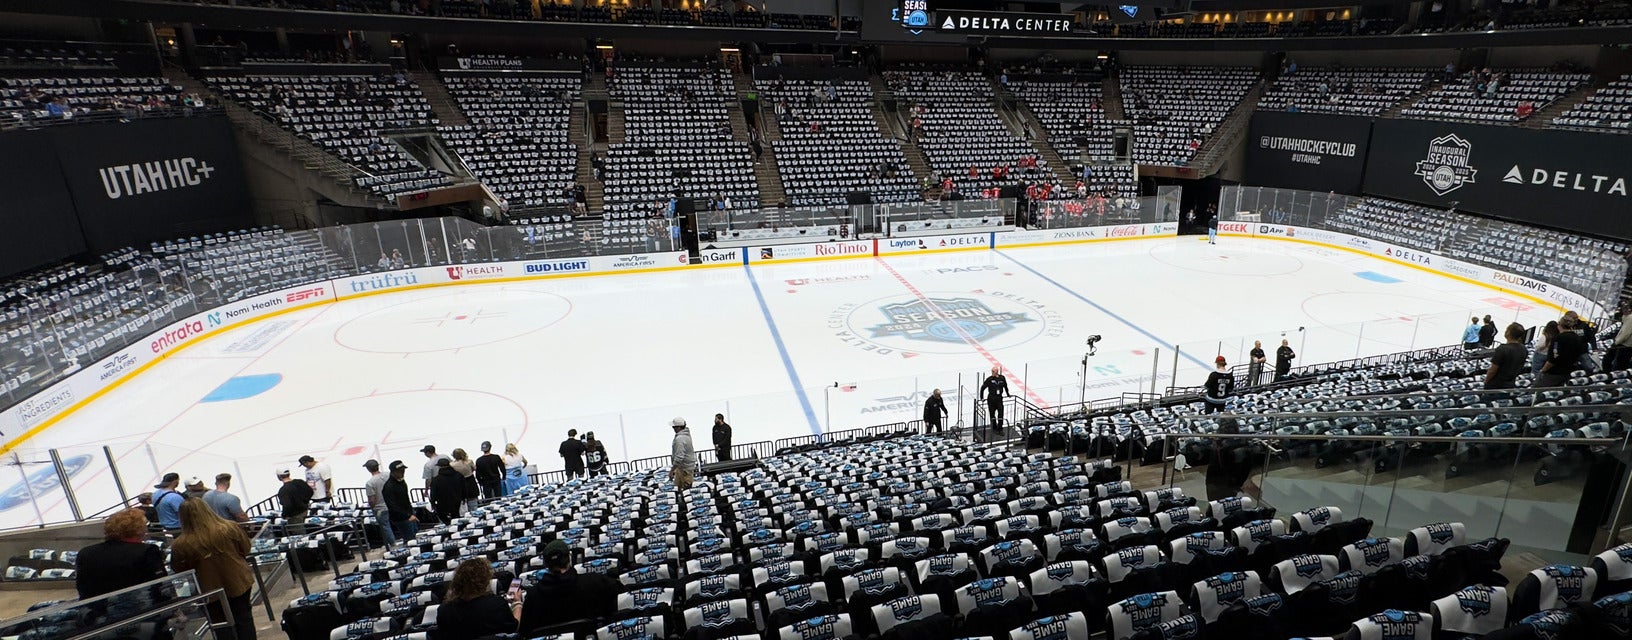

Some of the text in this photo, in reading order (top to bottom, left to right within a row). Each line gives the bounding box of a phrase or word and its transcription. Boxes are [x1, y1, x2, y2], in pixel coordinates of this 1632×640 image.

[959, 16, 1071, 31] DELTA CENTER
[472, 59, 499, 67] HEALTH
[1260, 136, 1356, 158] @UTAHHOCKEYCLUB
[1431, 145, 1467, 156] INAUGURAL
[1291, 154, 1321, 165] #UTAHHC
[1429, 152, 1466, 167] SEASON
[99, 157, 215, 199] UTAH HC+
[1435, 172, 1451, 183] UTAH
[1531, 168, 1628, 197] DELTA
[951, 236, 985, 245] DELTA
[1054, 231, 1075, 239] ZIONS
[890, 239, 916, 248] Layton
[711, 251, 736, 261] Garff
[1395, 249, 1431, 264] DELTA
[466, 266, 503, 275] HEALTH
[526, 261, 587, 273] BUD LIGHT
[350, 271, 418, 292] trüfrü
[286, 287, 325, 302] ESPN
[1549, 291, 1572, 306] ZIONS
[225, 307, 250, 318] Nomi
[252, 297, 283, 311] Health
[893, 306, 992, 323] SEASON
[151, 320, 204, 354] entrata
[100, 356, 138, 381] AMERICA FIRST
[1216, 383, 1227, 397] 9
[22, 390, 72, 422] INGREDIENTS
[860, 400, 924, 414] AMERIC
[586, 450, 601, 463] 66
[956, 526, 974, 534] GAME
[1251, 523, 1273, 535] GAME
[1430, 523, 1450, 534] GAME
[1060, 532, 1081, 541] GAME
[1187, 535, 1210, 546] GAME
[834, 548, 856, 558] GAME
[999, 547, 1021, 559] GAME
[1120, 548, 1144, 559] GAME
[1364, 543, 1390, 556] GAME
[701, 555, 720, 565] GAME
[930, 556, 954, 567] GAME
[1047, 560, 1071, 571] GAME
[1294, 555, 1320, 568] GAME
[767, 561, 790, 573] GAME
[635, 569, 657, 582] GAME
[701, 574, 725, 586] GAME
[859, 570, 884, 584] GAME
[1217, 580, 1244, 596] GAME
[1330, 576, 1360, 591] GAME
[1556, 576, 1581, 589] GAME
[634, 592, 658, 602] GAME
[784, 585, 811, 600] GAME
[976, 587, 1004, 603] GAME
[1456, 589, 1489, 603] GAME
[394, 596, 421, 609] GAME
[703, 600, 730, 614] GAME
[892, 596, 920, 612] GAME
[1132, 605, 1161, 621] GAME
[348, 620, 374, 631] GAME
[1033, 619, 1067, 639] GAME
[1163, 614, 1194, 631] GAME
[617, 623, 645, 640] GAME
[803, 625, 835, 640] GAME
[1382, 622, 1416, 637] GAME
